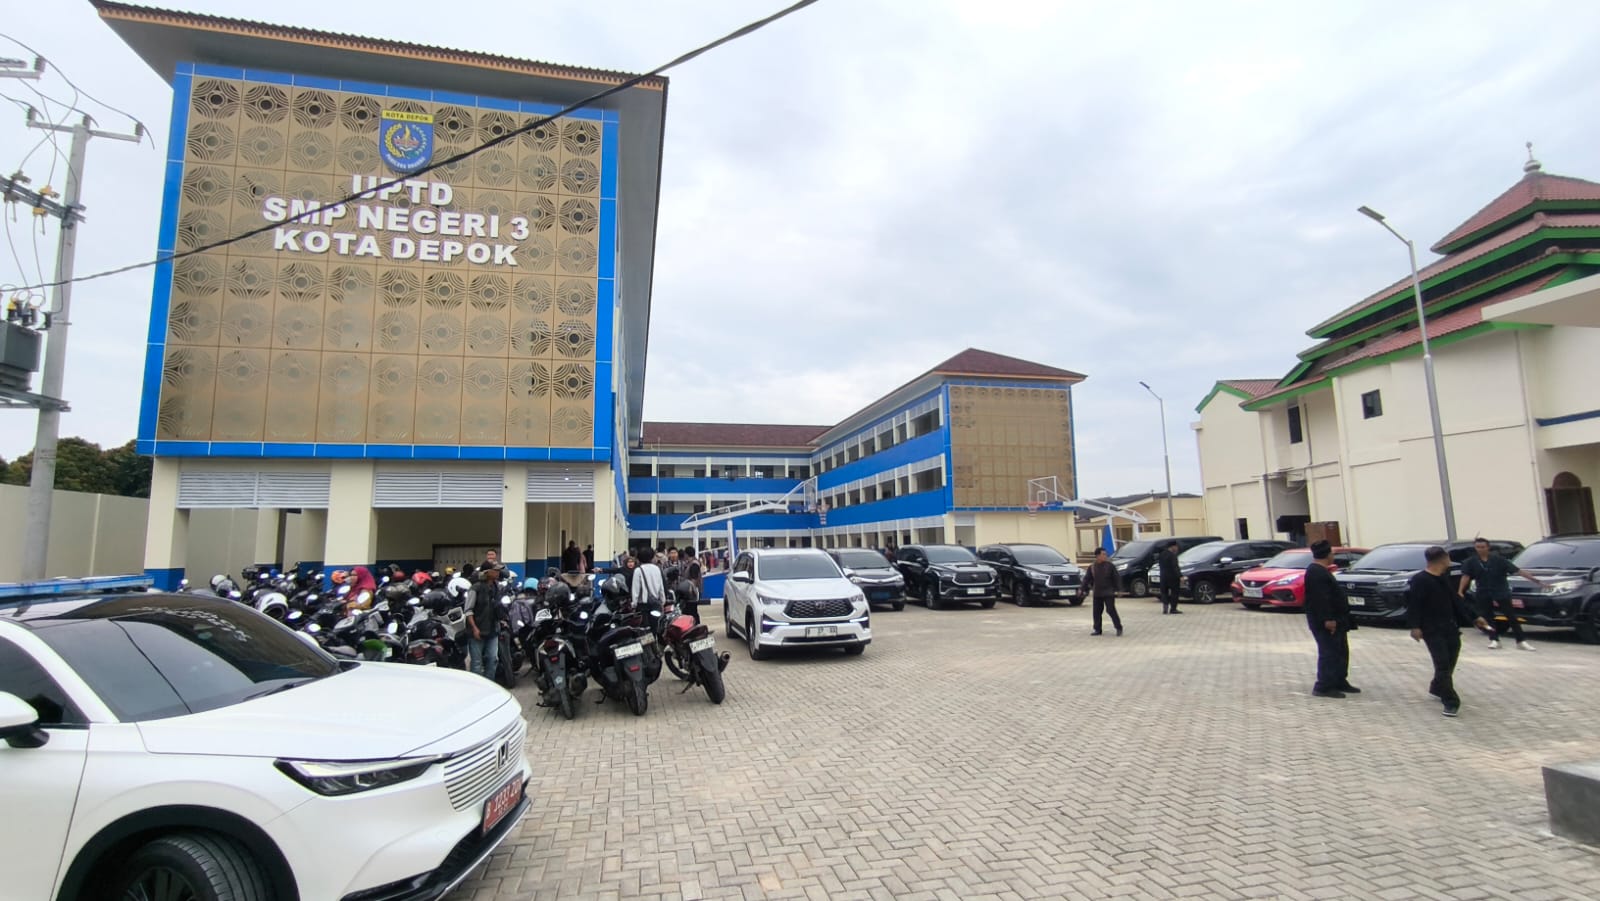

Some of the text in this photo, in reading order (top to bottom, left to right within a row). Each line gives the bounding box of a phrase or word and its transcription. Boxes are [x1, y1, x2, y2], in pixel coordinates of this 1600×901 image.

[352, 174, 453, 206] UPTD
[263, 197, 530, 240] SMP NEGERI 3
[274, 228, 518, 266] KOTA DEPOK
